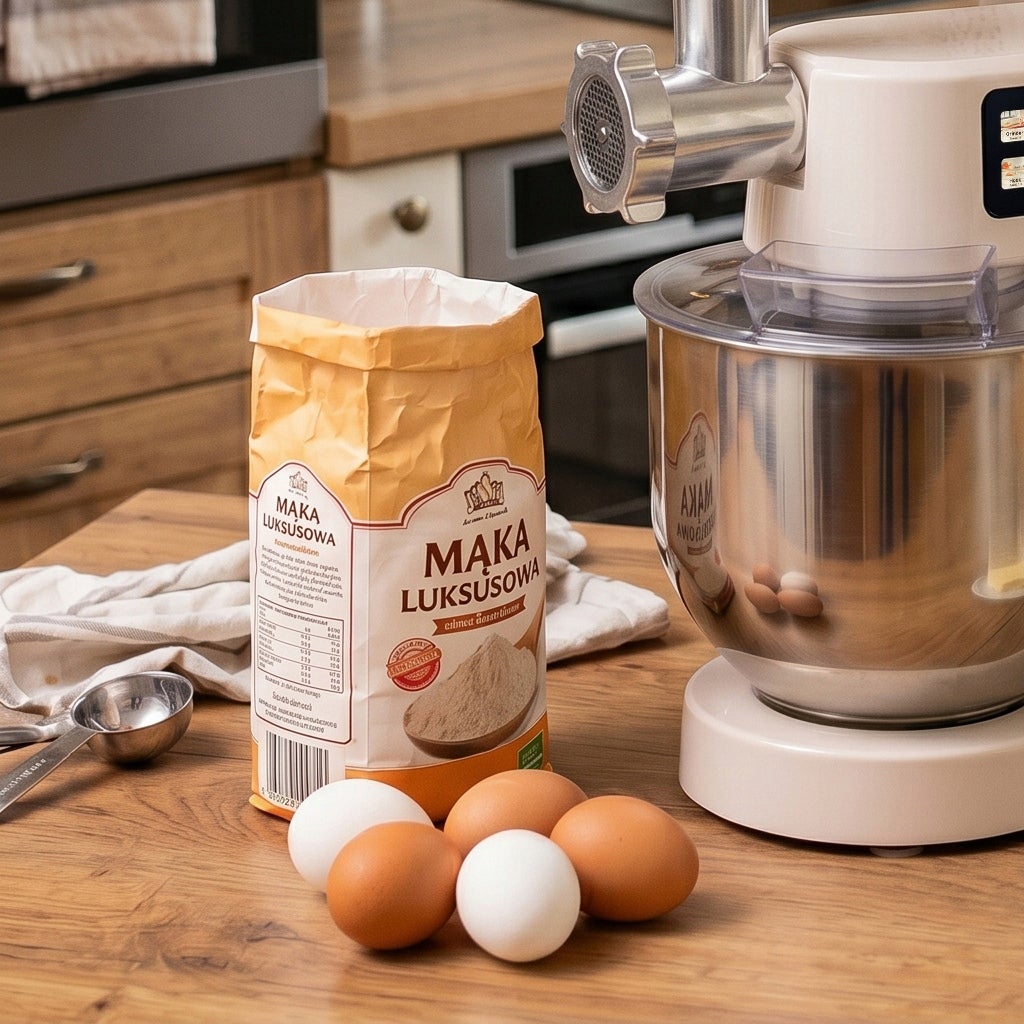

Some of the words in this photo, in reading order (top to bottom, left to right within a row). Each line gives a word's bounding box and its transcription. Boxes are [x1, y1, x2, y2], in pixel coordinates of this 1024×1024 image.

[263, 512, 336, 547] LUKSUSOWA
[424, 517, 531, 578] MĄKA
[401, 556, 540, 613] LUKSUSOWA
